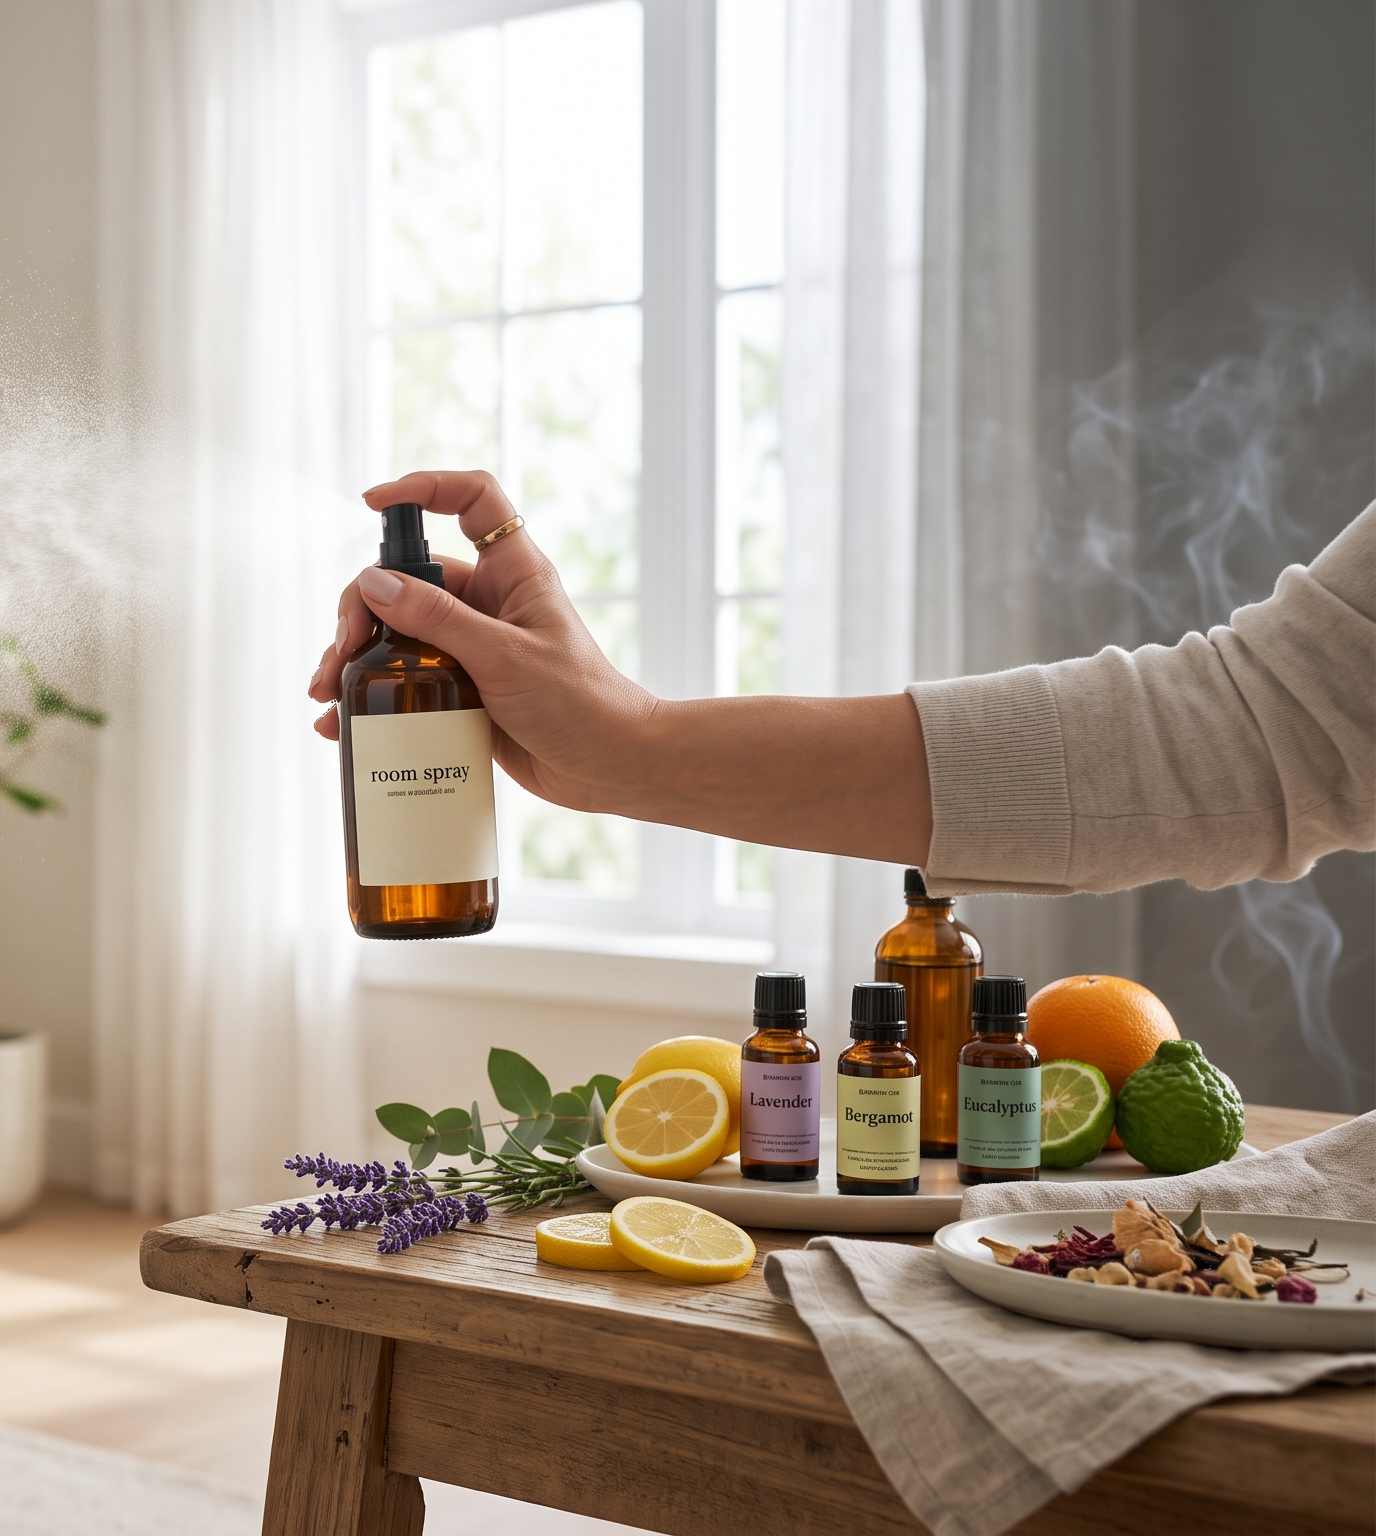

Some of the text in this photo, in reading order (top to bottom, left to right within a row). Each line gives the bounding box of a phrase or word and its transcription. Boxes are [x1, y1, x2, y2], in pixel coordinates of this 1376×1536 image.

[371, 765, 470, 784] room spray
[750, 1092, 813, 1109] Lavender
[964, 1096, 1037, 1118] Eucalyptus
[845, 1106, 914, 1128] Bergamot
